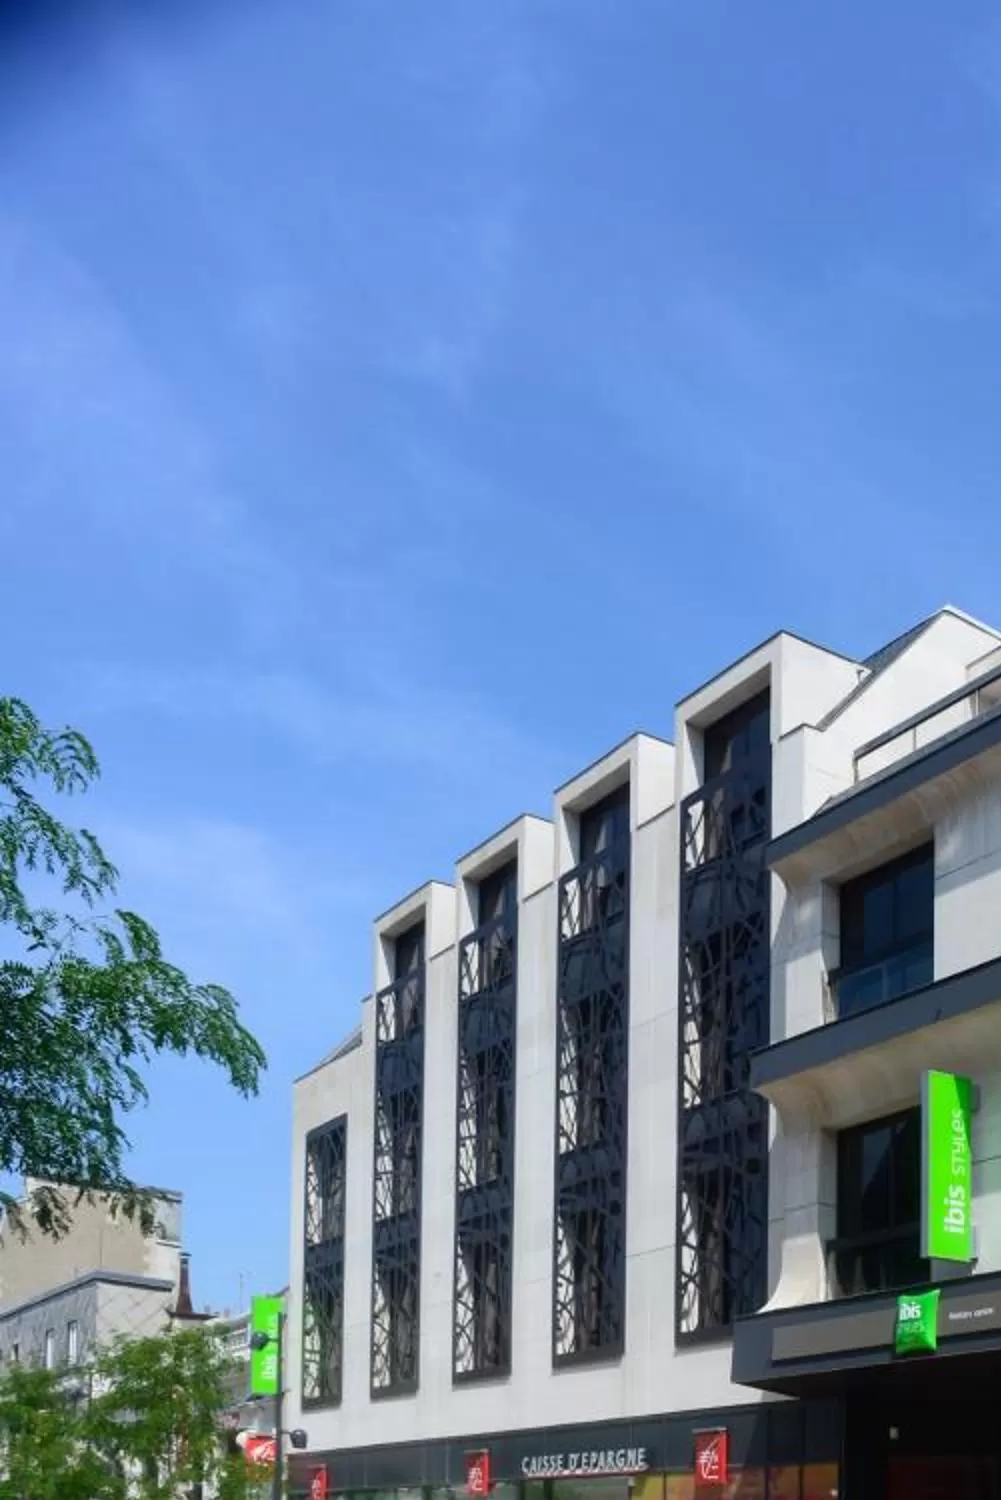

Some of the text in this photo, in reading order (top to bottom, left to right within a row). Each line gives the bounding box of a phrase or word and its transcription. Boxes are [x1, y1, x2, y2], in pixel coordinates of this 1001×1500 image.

[943, 1184, 966, 1234] ibis
[521, 1448, 646, 1474] CAISSE D'EPARGNE
